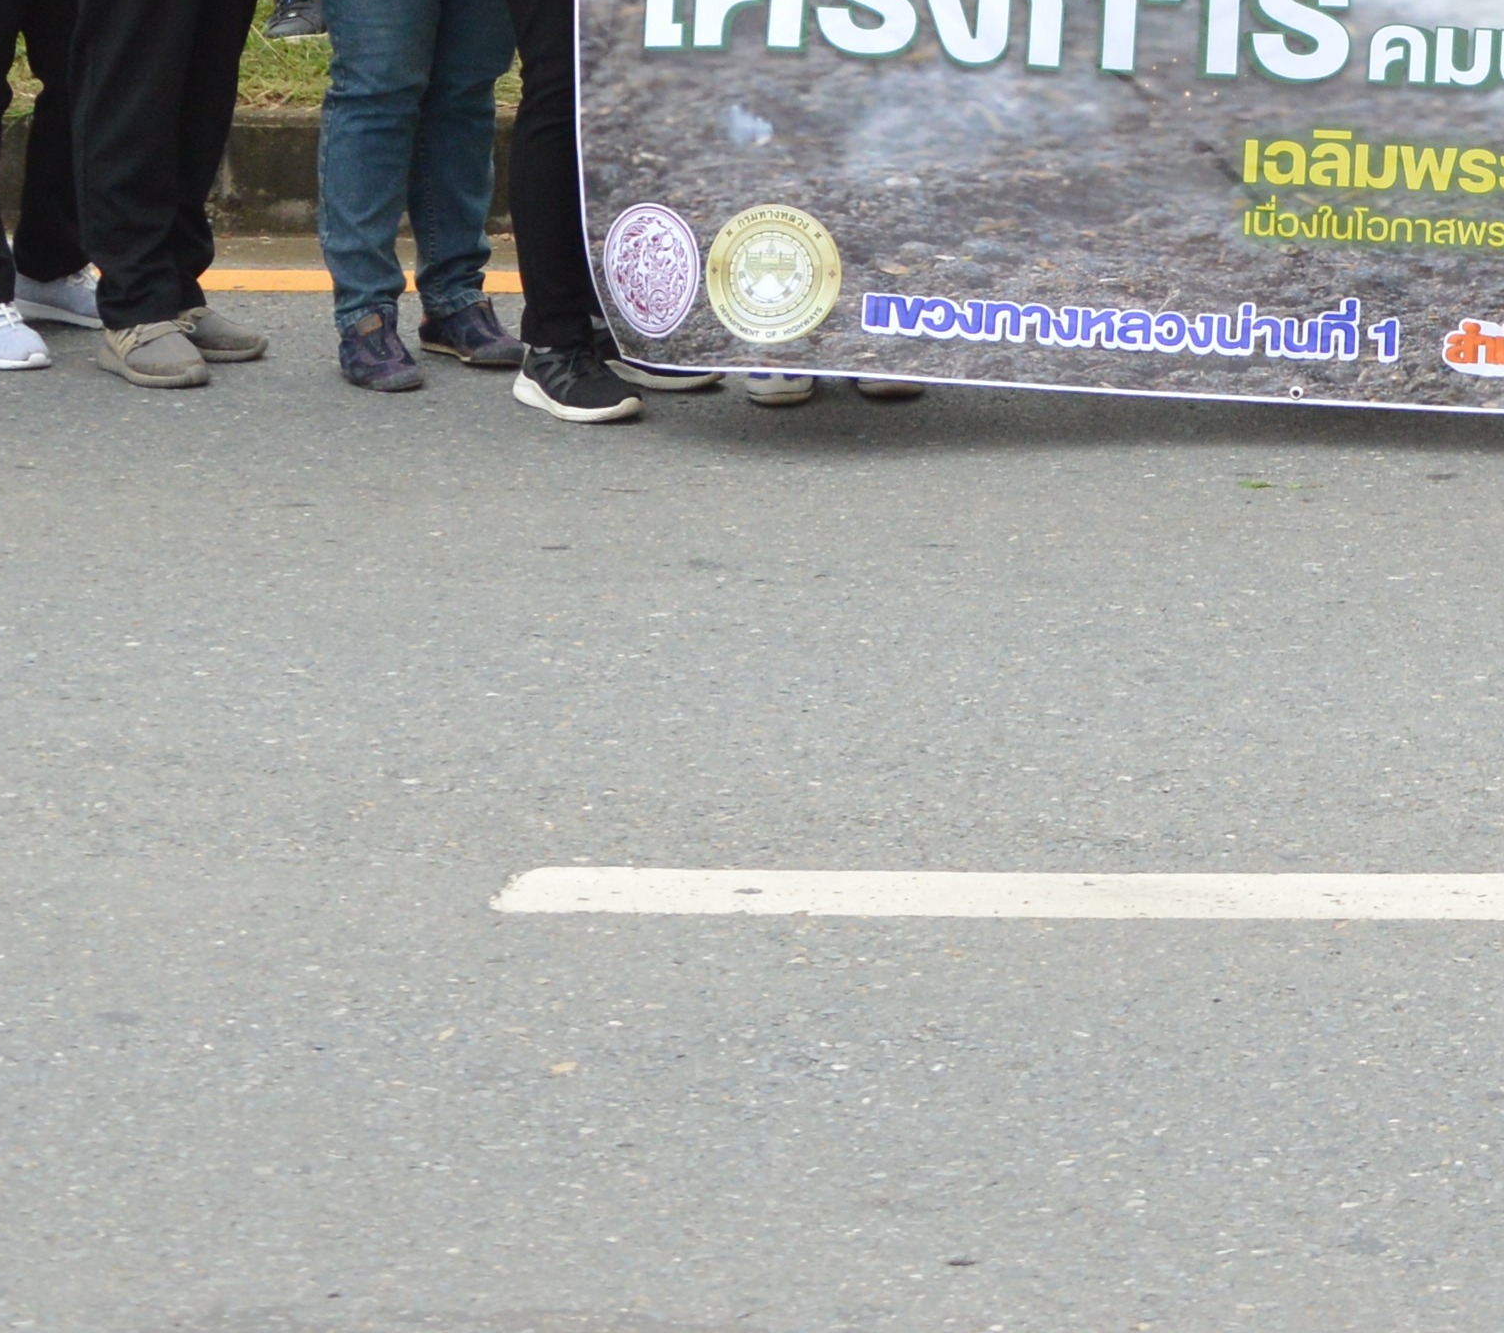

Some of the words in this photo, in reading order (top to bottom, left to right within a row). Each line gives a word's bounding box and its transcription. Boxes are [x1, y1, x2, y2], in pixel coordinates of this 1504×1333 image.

[737, 207, 810, 231] กรมทางหลวง
[718, 303, 760, 338] DEPARTMENT
[765, 330, 778, 339] OF
[782, 306, 824, 337] HIGHWAYS
[863, 294, 1361, 361] แขวงทางหลวงน่านที่
[1369, 318, 1400, 363] 1
